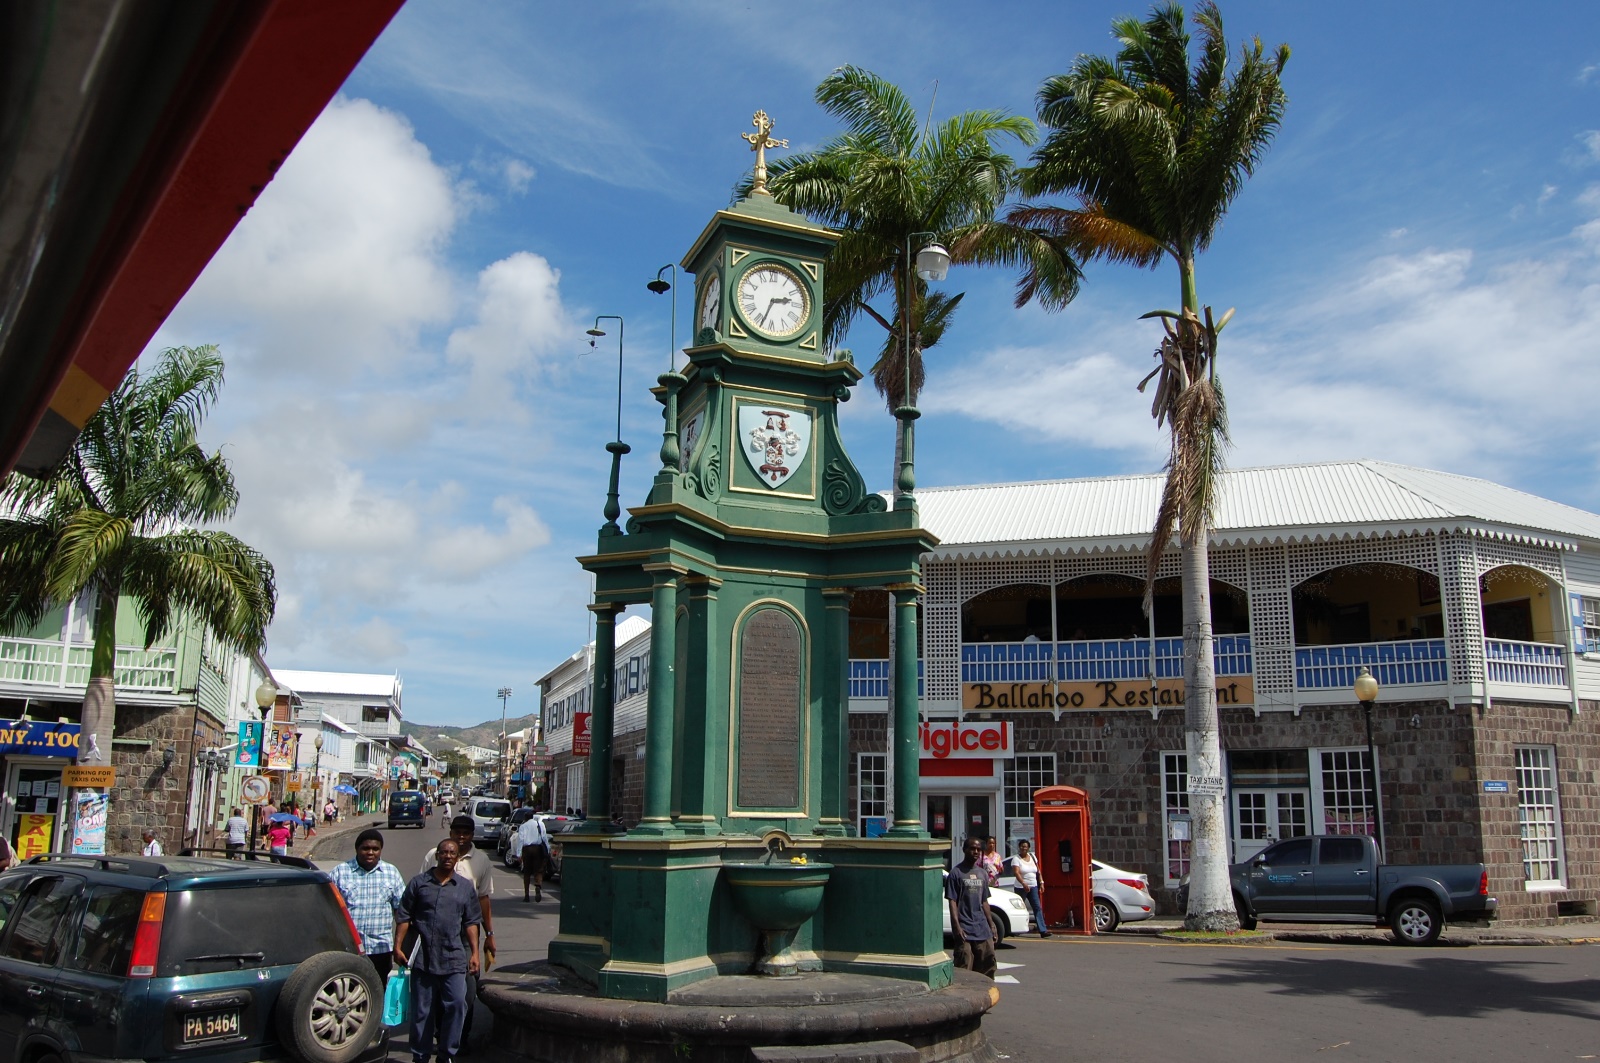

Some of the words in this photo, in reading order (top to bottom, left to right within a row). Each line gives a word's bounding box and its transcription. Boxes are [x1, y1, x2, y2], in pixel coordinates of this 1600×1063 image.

[971, 683, 1084, 708] Ballahoo
[1095, 681, 1239, 707] Restaunt
[919, 720, 1008, 759] igicel
[1203, 777, 1224, 786] STAND
[25, 814, 46, 860] SALE
[187, 1017, 204, 1037] PA
[206, 1013, 238, 1035] 5464
